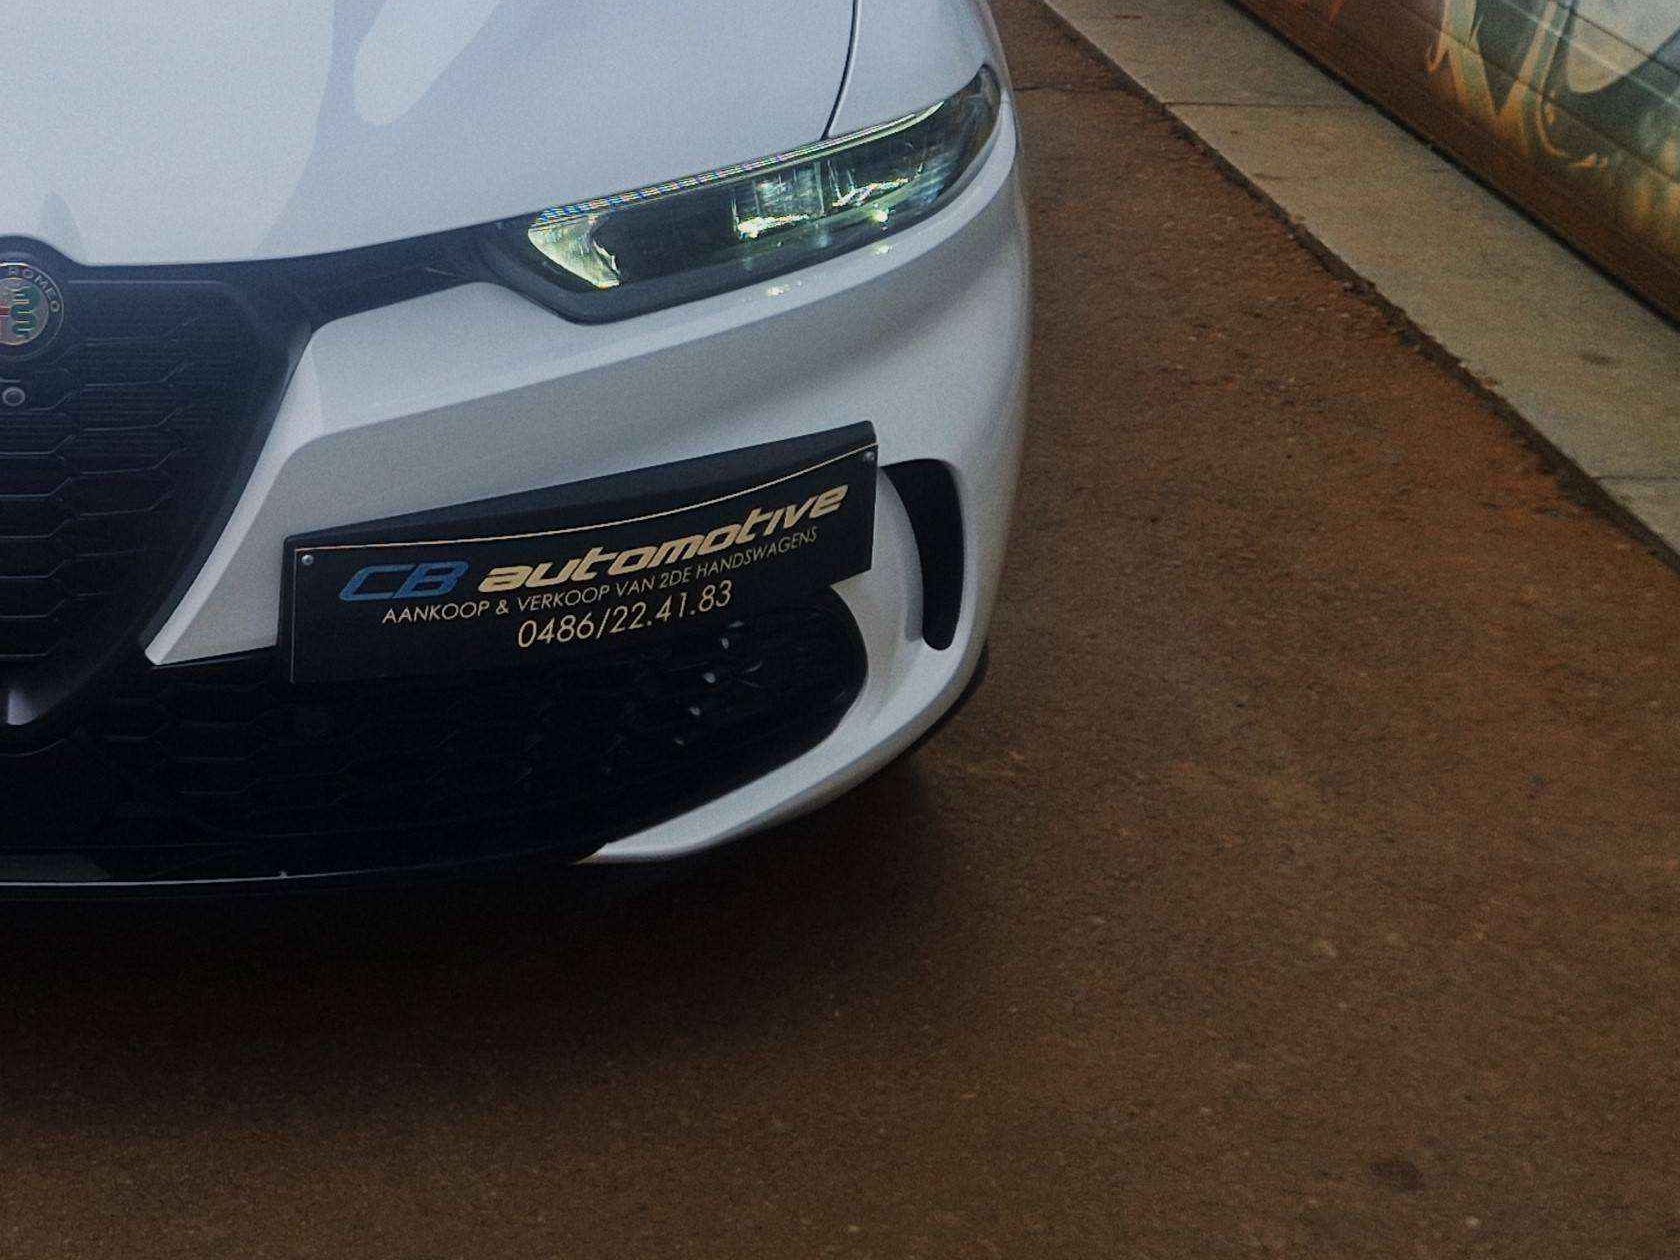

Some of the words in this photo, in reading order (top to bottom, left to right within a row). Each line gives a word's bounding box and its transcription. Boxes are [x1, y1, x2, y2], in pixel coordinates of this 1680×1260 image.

[8, 267, 60, 313] ROMEO
[339, 560, 469, 602] CB
[477, 484, 849, 593] automotive
[381, 599, 490, 624] AANKOOP
[495, 599, 510, 616] &
[517, 584, 610, 612] VERKOOP
[615, 575, 656, 597] VAN
[658, 565, 693, 589] 2DE
[695, 525, 818, 580] HANDSWAGENS
[517, 579, 733, 649] 0486/22.41.83
